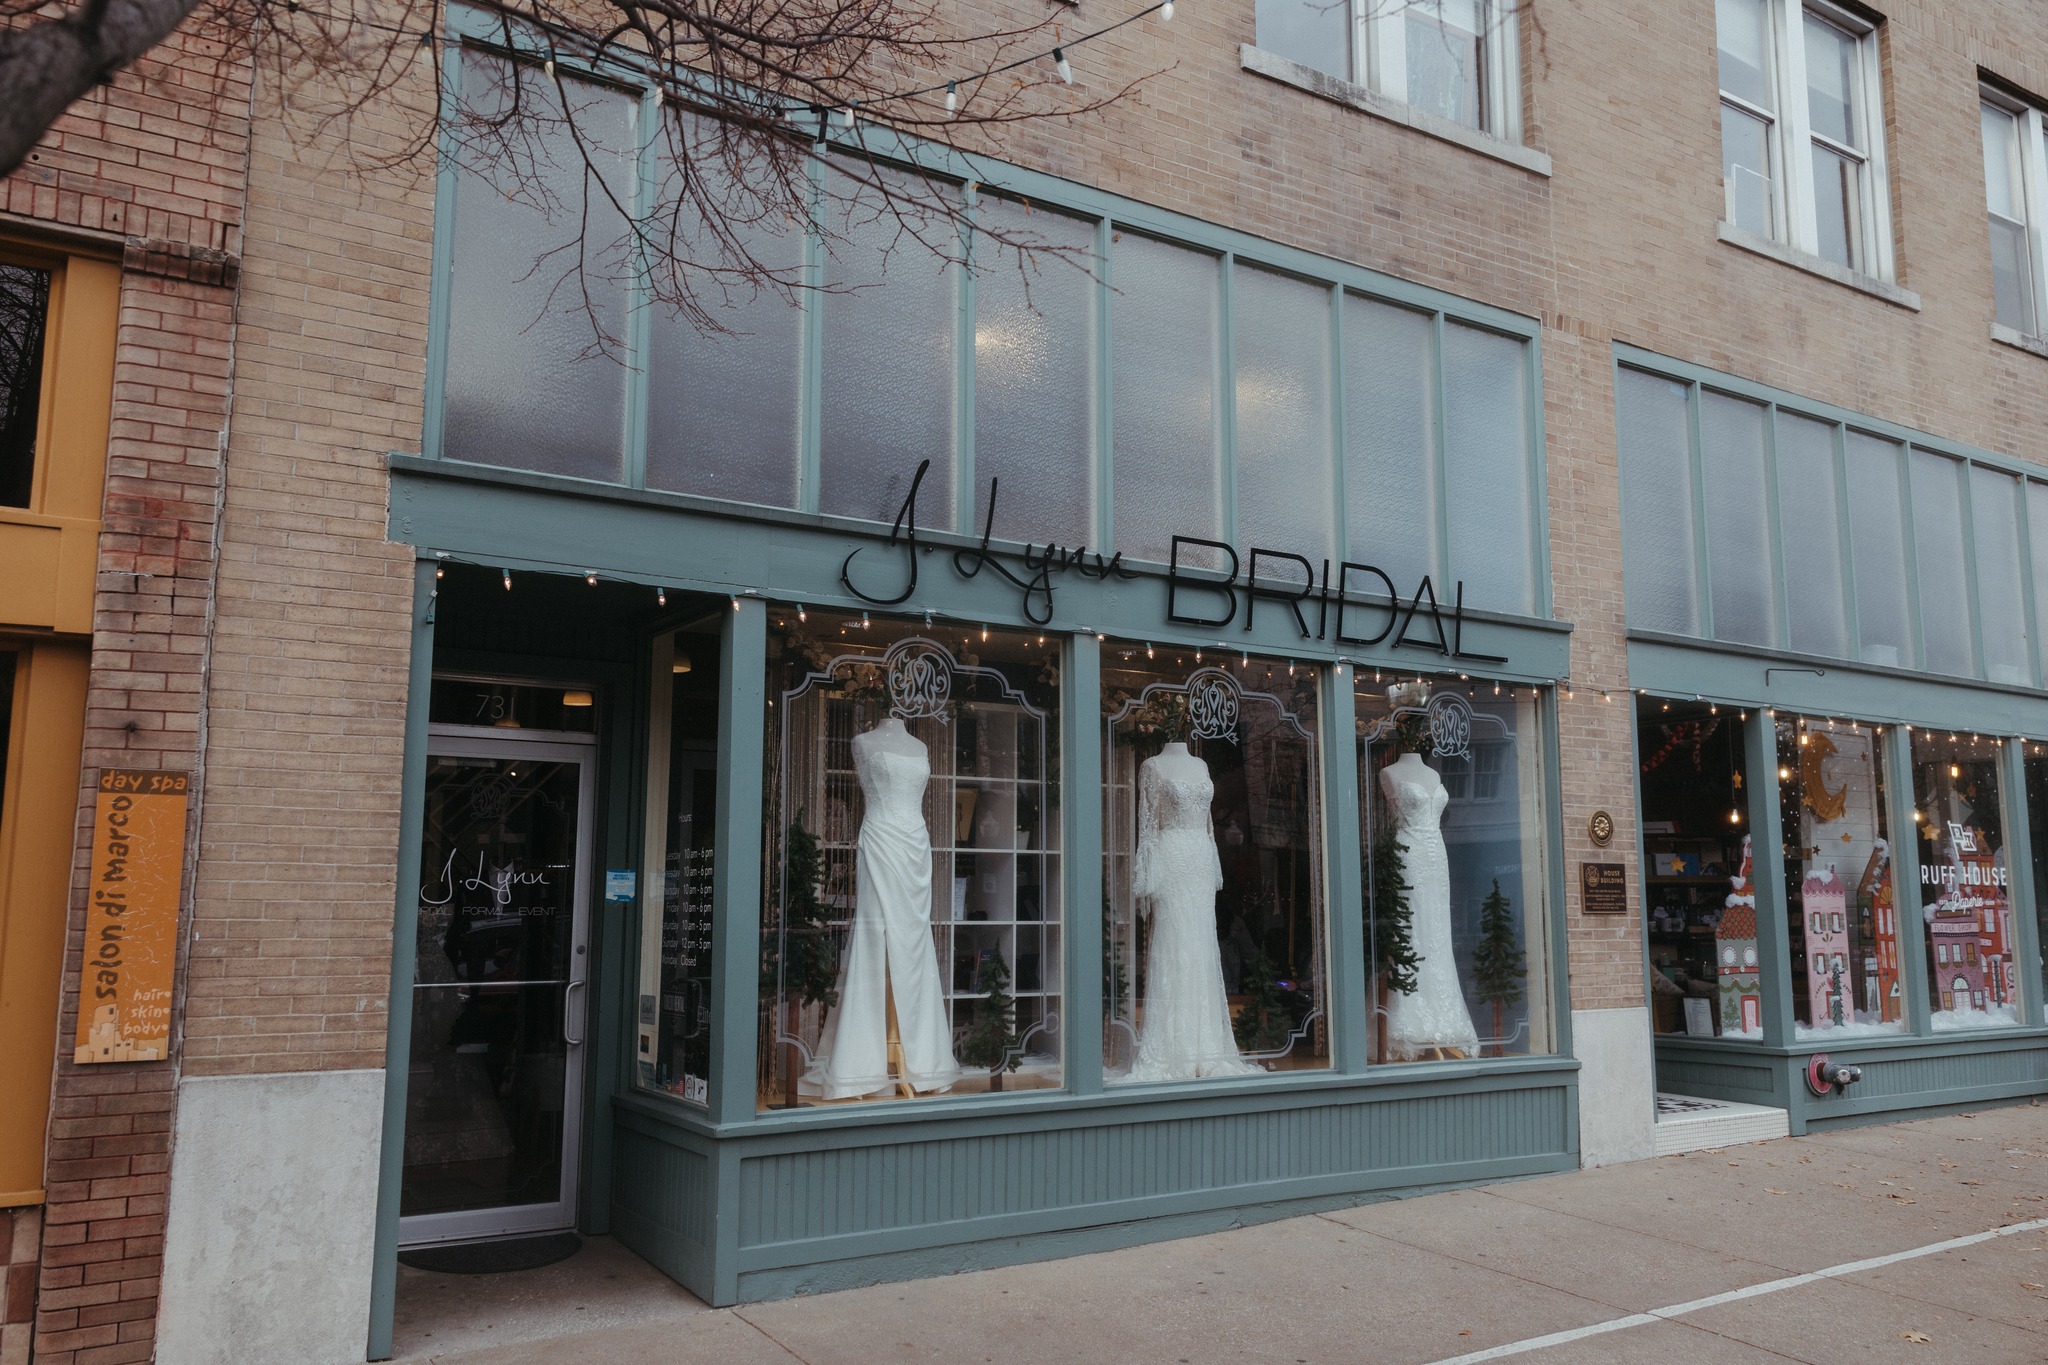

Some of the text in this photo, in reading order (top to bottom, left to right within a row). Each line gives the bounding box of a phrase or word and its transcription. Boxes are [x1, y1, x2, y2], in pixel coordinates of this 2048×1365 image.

[954, 476, 1141, 625] Lynn
[1168, 534, 1509, 663] BRIDAL
[476, 694, 514, 721] 731
[101, 770, 187, 793] day spa
[465, 850, 551, 905] Lynn
[1920, 864, 2007, 886] RUFF HOUSE
[95, 890, 128, 918] di
[462, 906, 510, 916] FORMAL
[518, 906, 557, 916] EVENT
[1951, 891, 1984, 915] Paperie
[89, 924, 126, 1000] salon
[680, 955, 697, 967] Closed
[133, 988, 164, 1001] hair
[130, 1004, 162, 1018] skin
[123, 1021, 161, 1036] body
